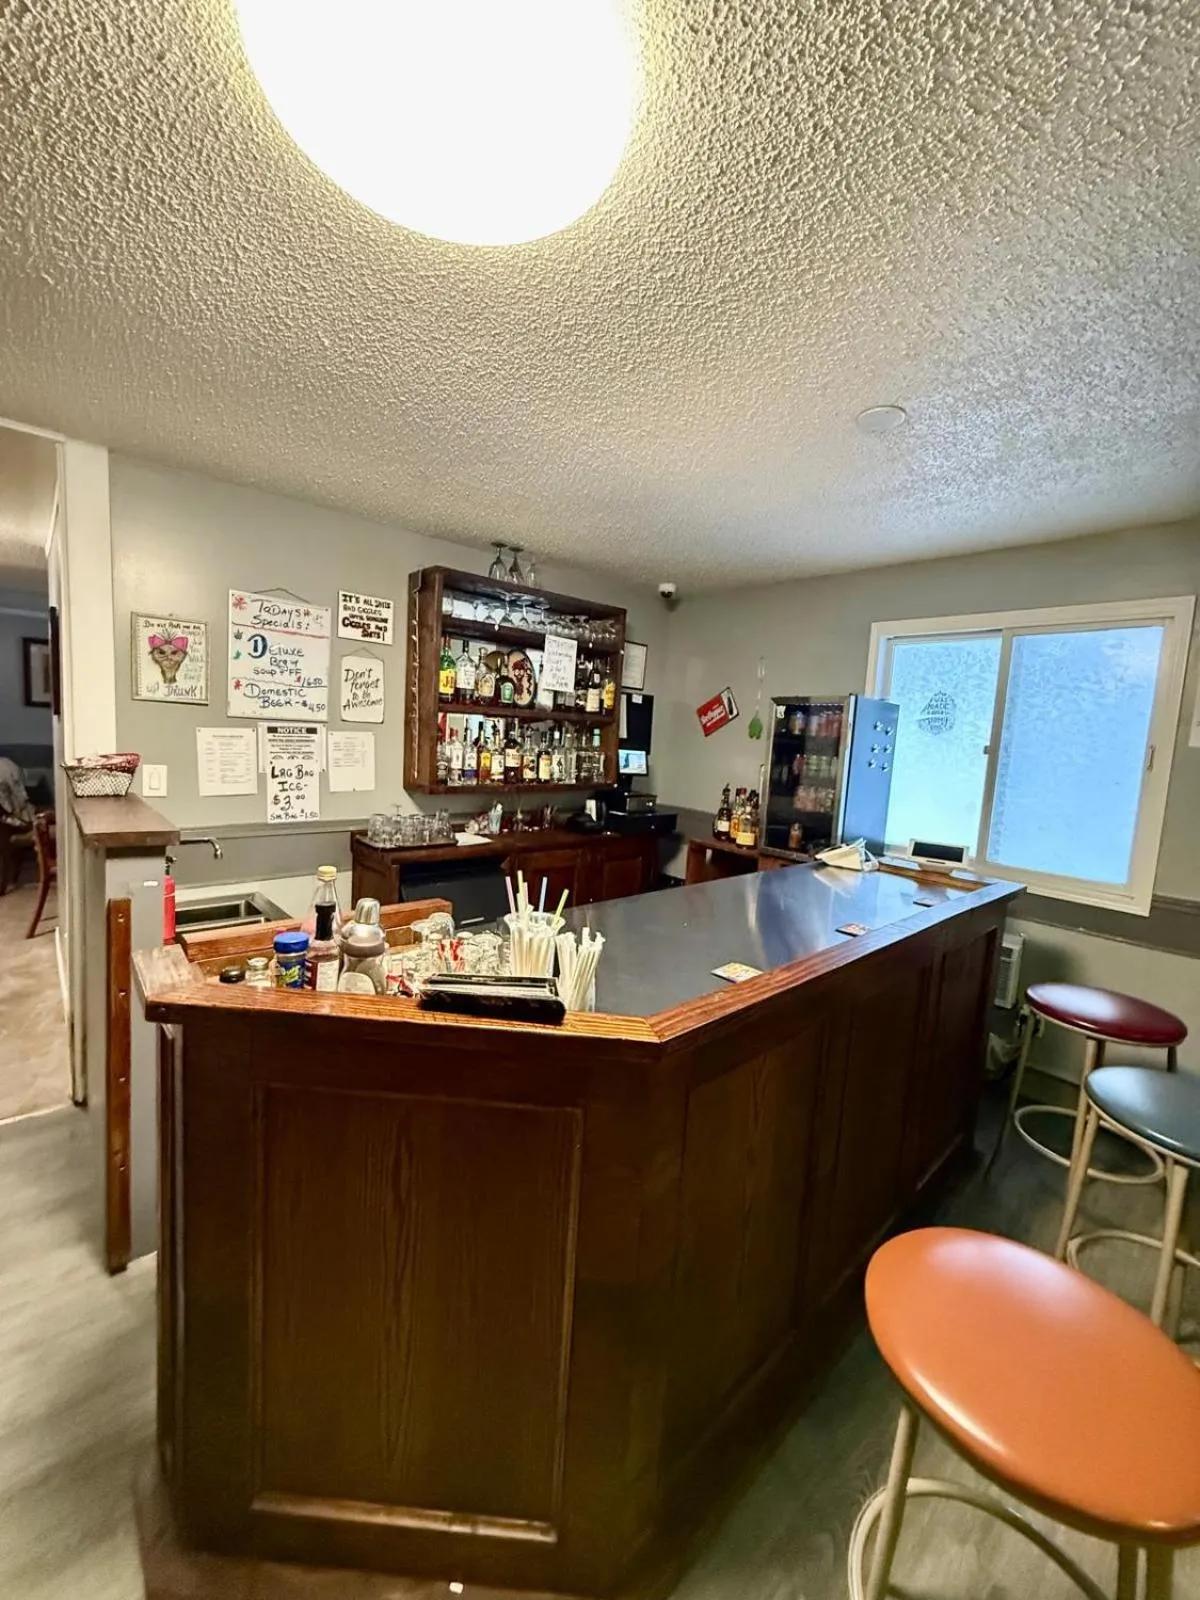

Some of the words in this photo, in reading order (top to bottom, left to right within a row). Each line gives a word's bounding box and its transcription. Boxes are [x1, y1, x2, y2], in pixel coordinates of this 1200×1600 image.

[342, 594, 360, 604] IT'S
[363, 599, 373, 607] ALL
[344, 668, 373, 682] Don't
[277, 727, 308, 735] NOTICE
